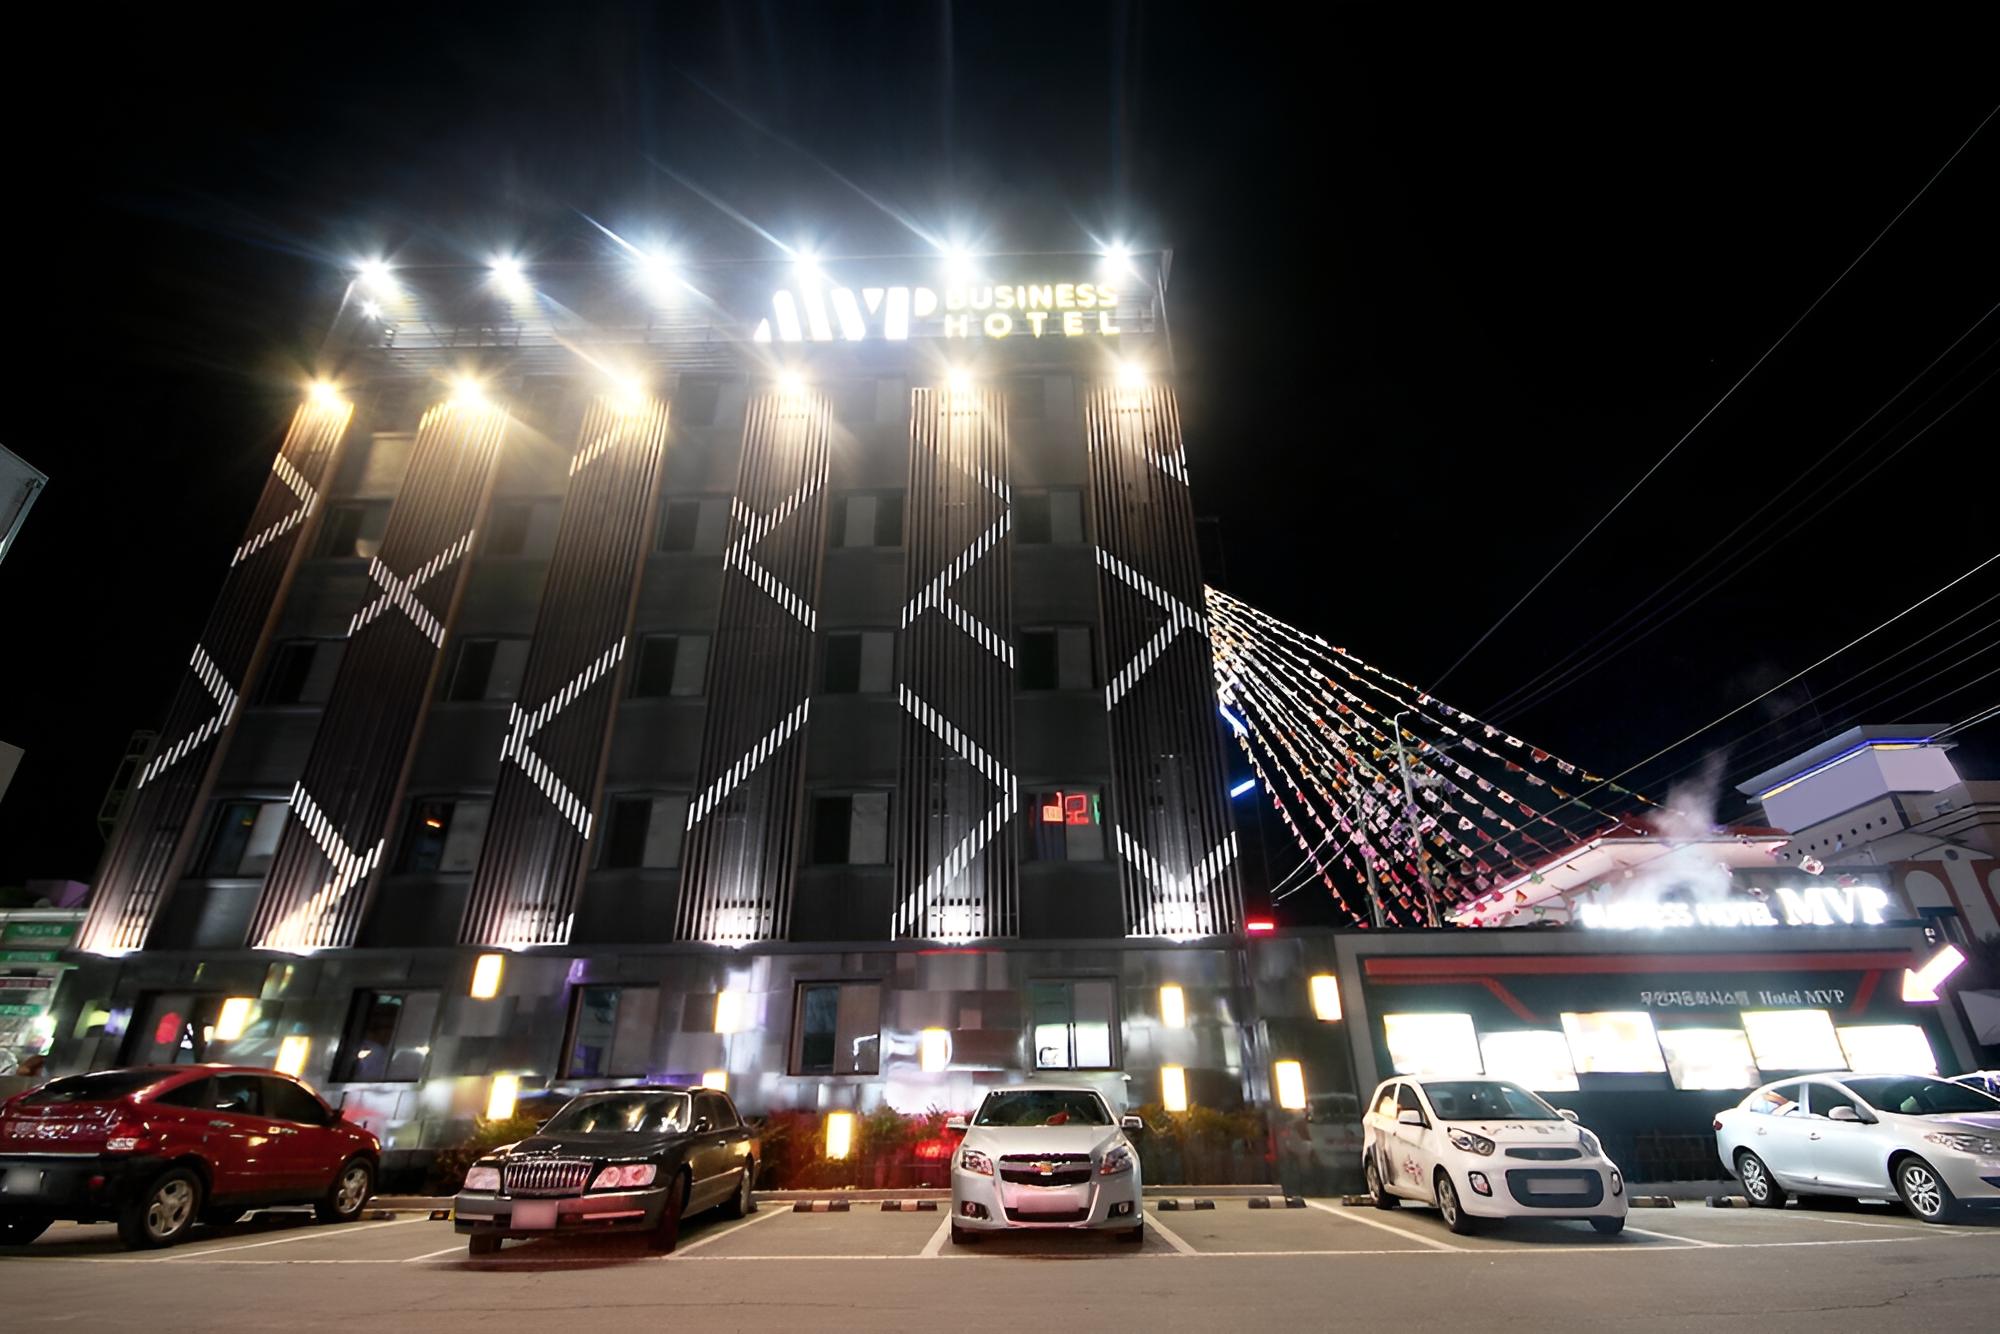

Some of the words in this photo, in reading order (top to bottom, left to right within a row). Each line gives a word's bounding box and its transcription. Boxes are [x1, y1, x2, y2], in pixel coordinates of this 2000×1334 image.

[945, 284, 1119, 310] BUSINESS
[944, 312, 1121, 339] HOTEL
[1775, 886, 1888, 926] MVP
[1759, 990, 1801, 1005] Hotel
[1804, 990, 1845, 1004] MVP
